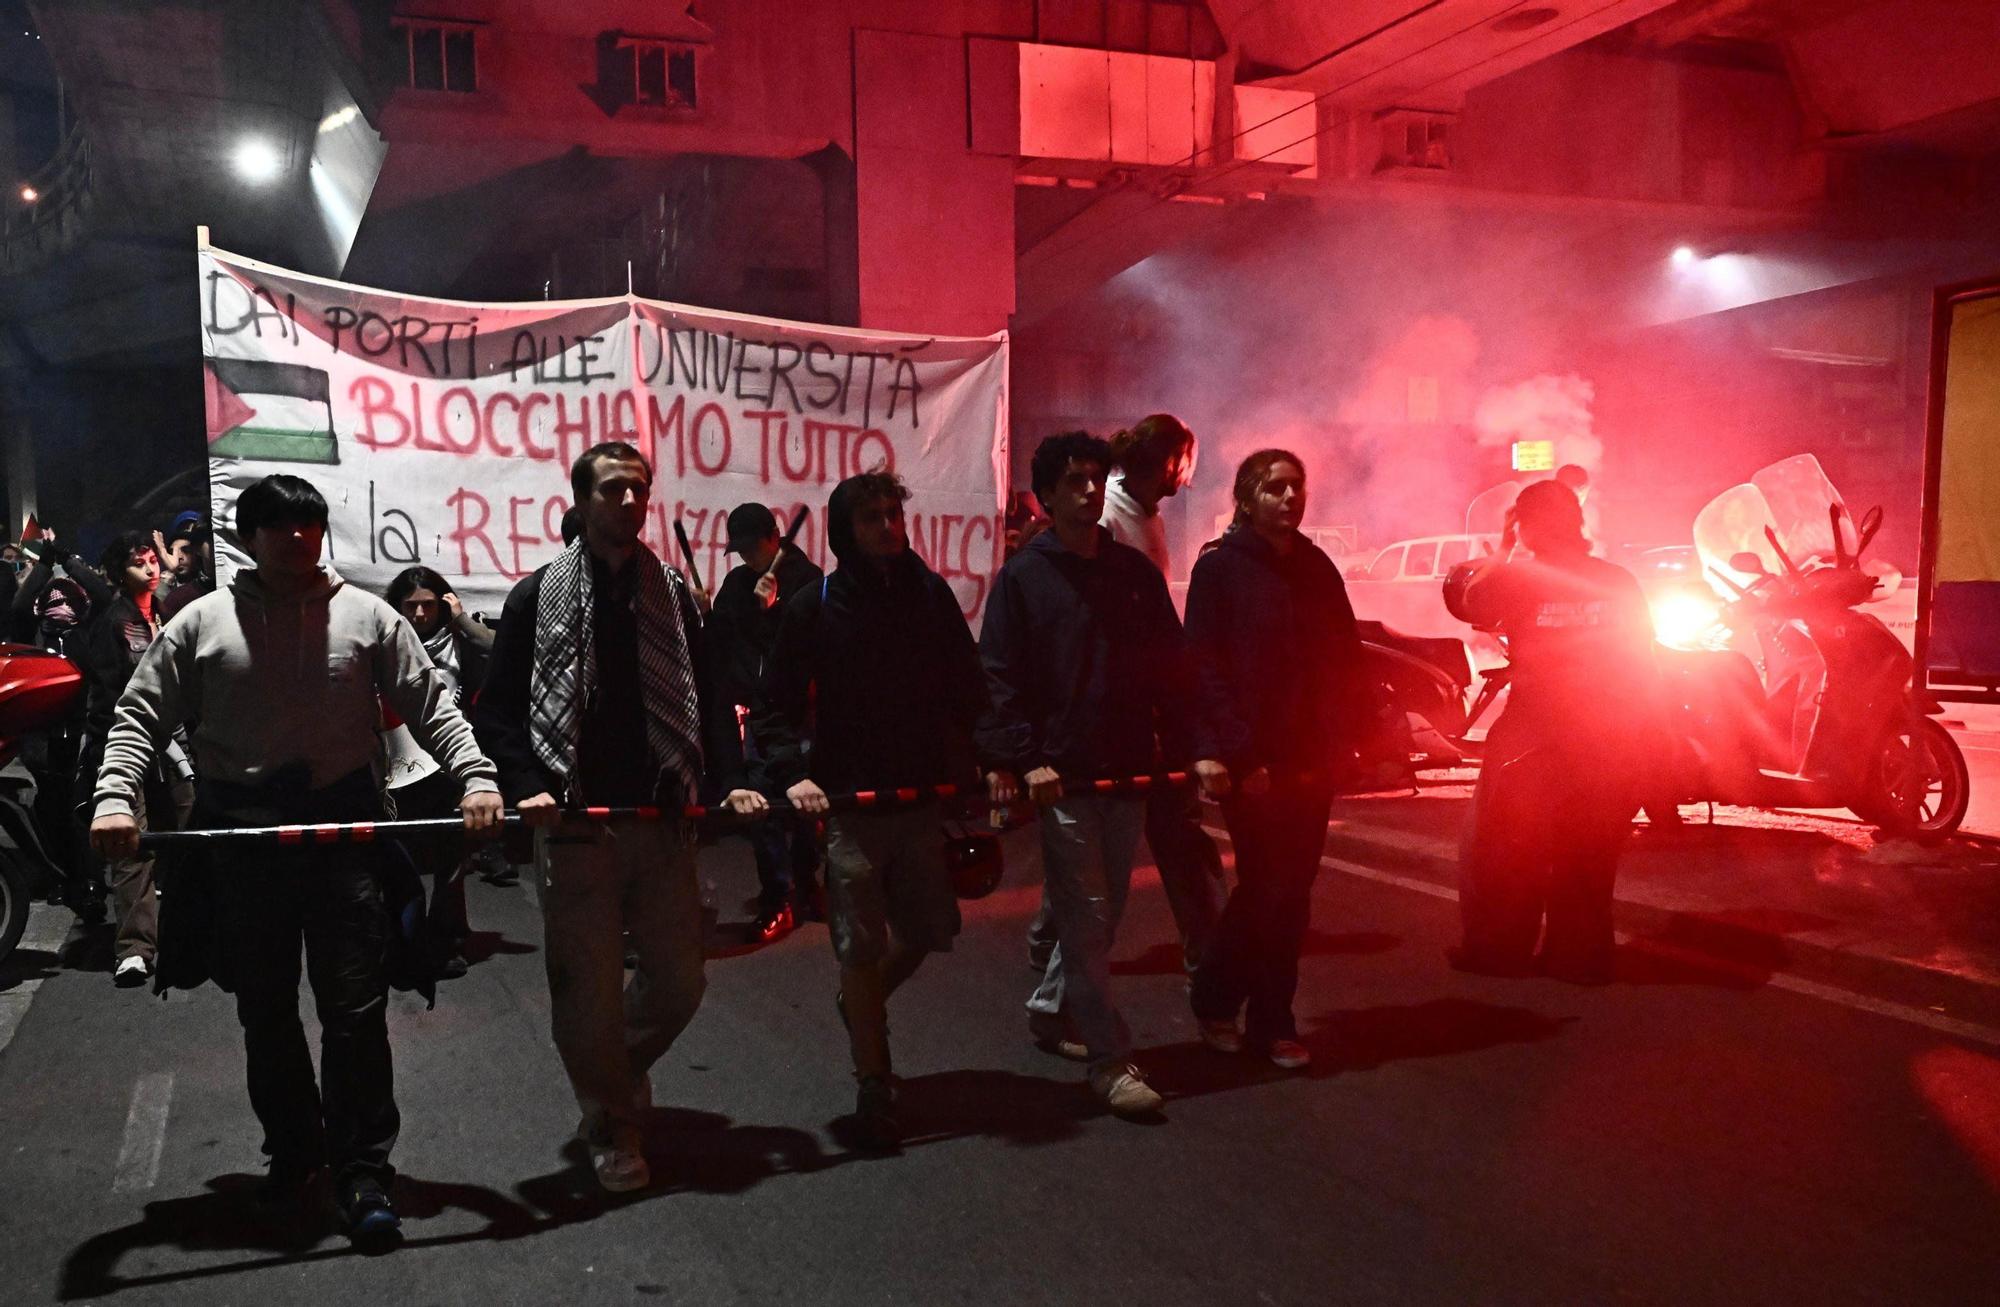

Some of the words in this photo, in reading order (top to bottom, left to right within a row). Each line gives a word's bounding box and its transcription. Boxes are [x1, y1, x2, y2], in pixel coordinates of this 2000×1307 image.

[206, 269, 299, 346] DAI
[501, 330, 616, 385] ALLE
[742, 410, 896, 486] TUTTO
[368, 480, 422, 564] la
